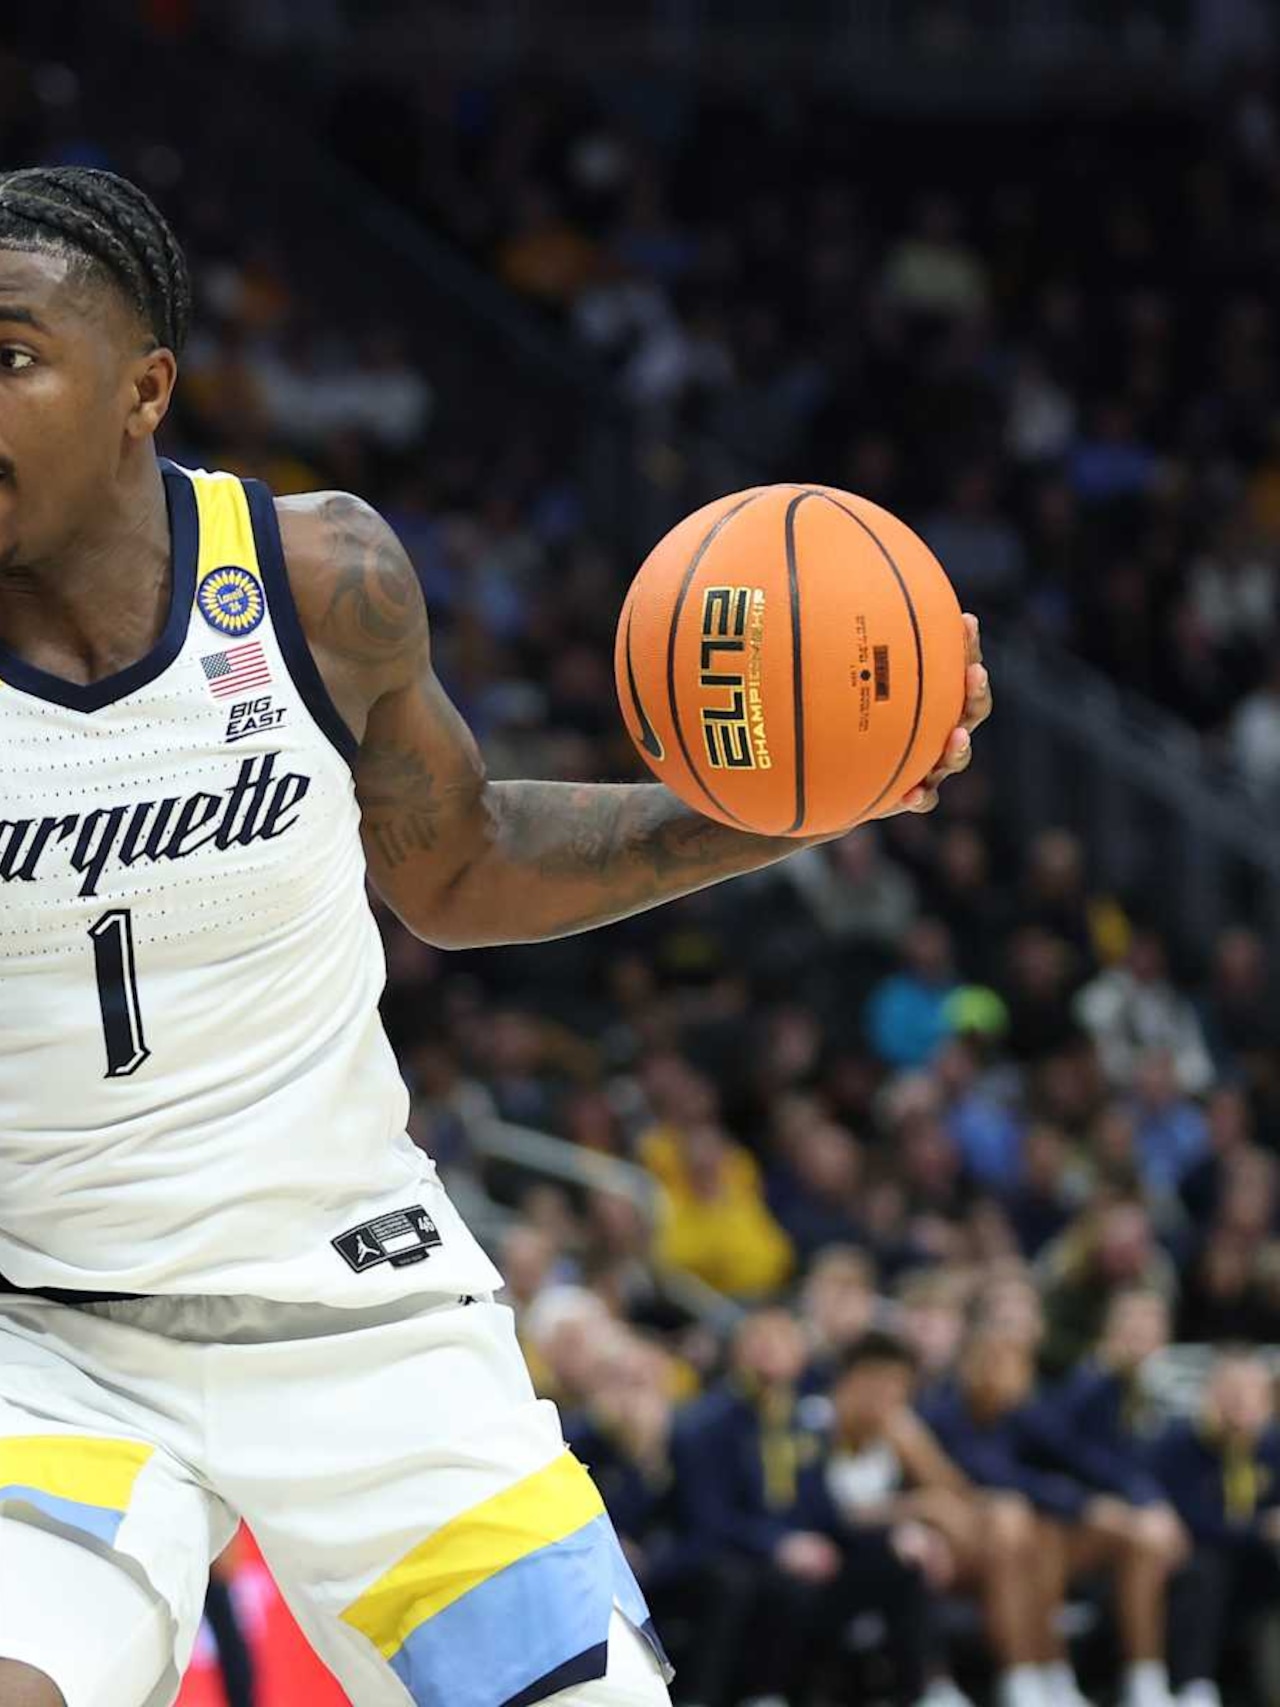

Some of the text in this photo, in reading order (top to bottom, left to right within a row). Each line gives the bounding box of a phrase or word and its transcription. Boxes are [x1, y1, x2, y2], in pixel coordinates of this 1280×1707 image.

[226, 708, 287, 735] EAST
[230, 696, 272, 719] BIG
[700, 586, 756, 769] ELITE
[749, 588, 772, 770] CHAMPIONSHIP
[88, 909, 151, 1078] 1
